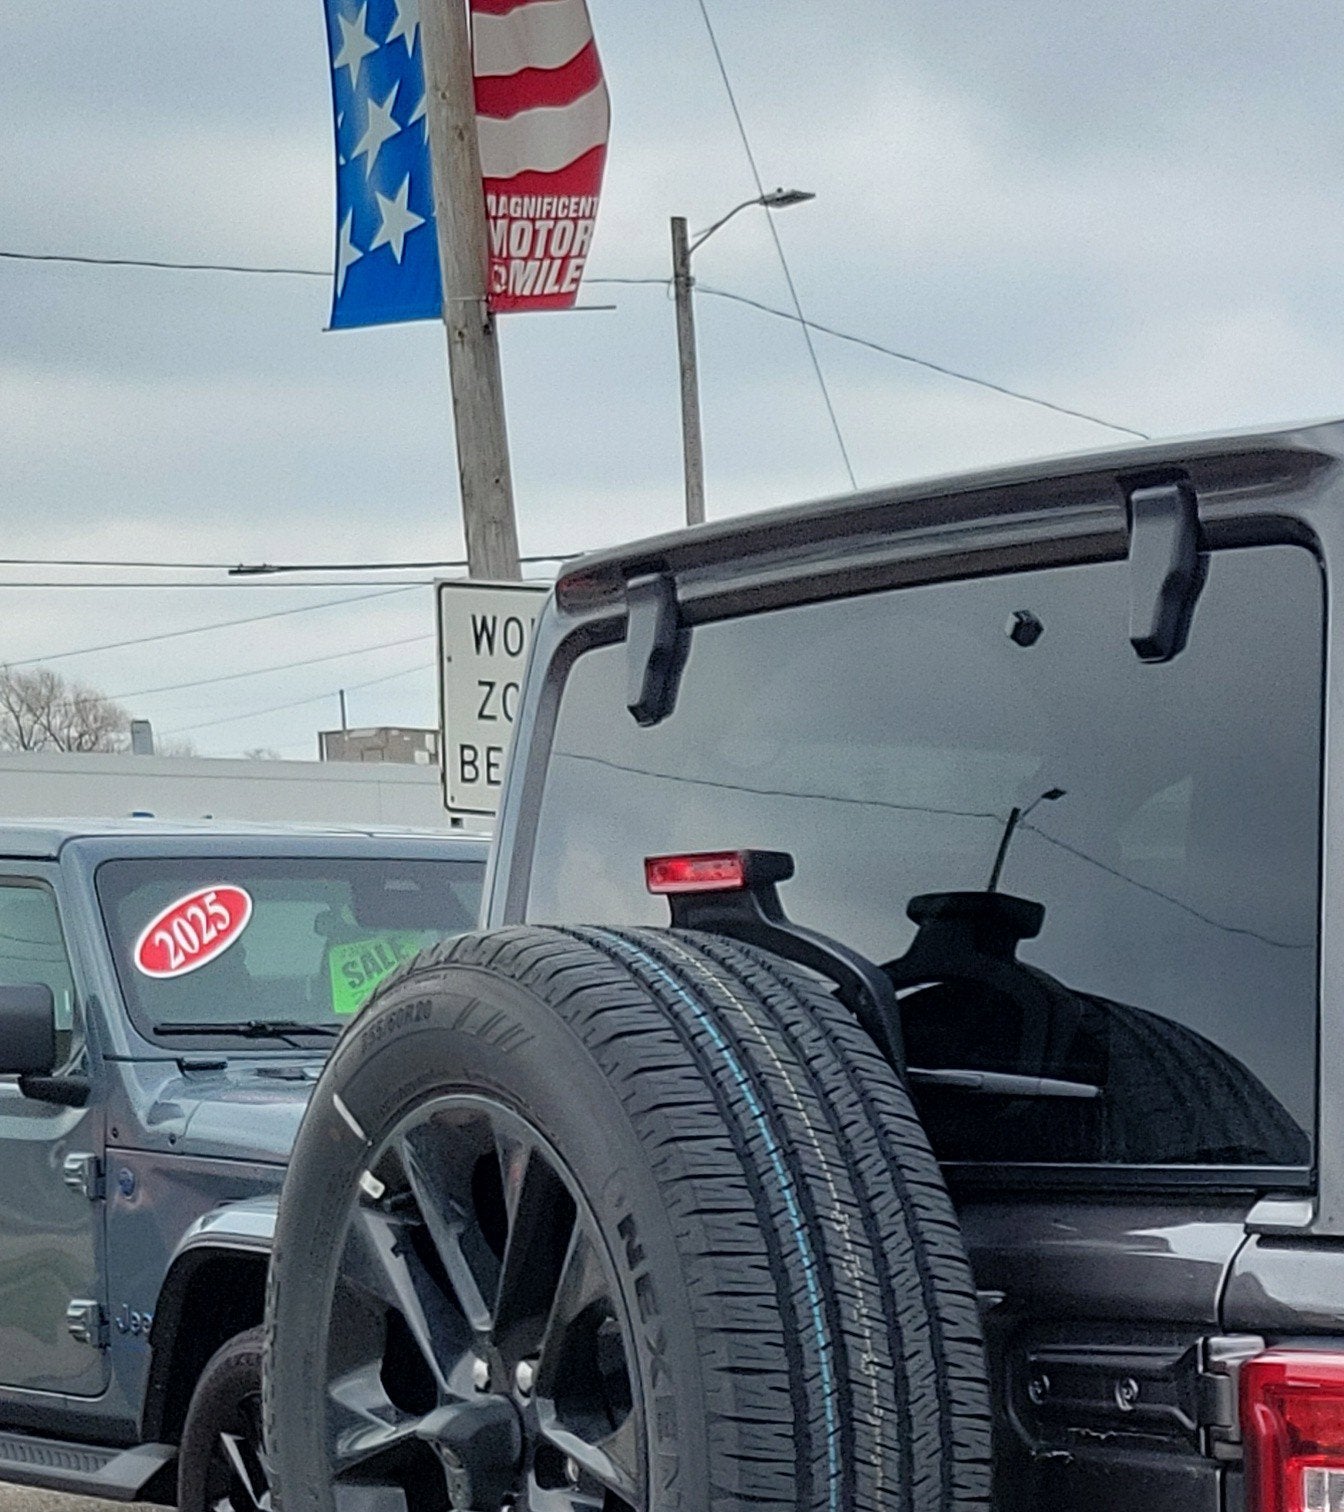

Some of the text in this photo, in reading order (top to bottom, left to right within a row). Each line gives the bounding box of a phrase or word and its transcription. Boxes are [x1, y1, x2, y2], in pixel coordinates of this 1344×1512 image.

[490, 219, 594, 258] MOTOR
[507, 258, 585, 296] MILE
[471, 613, 535, 657] WO
[154, 891, 231, 970] 2025
